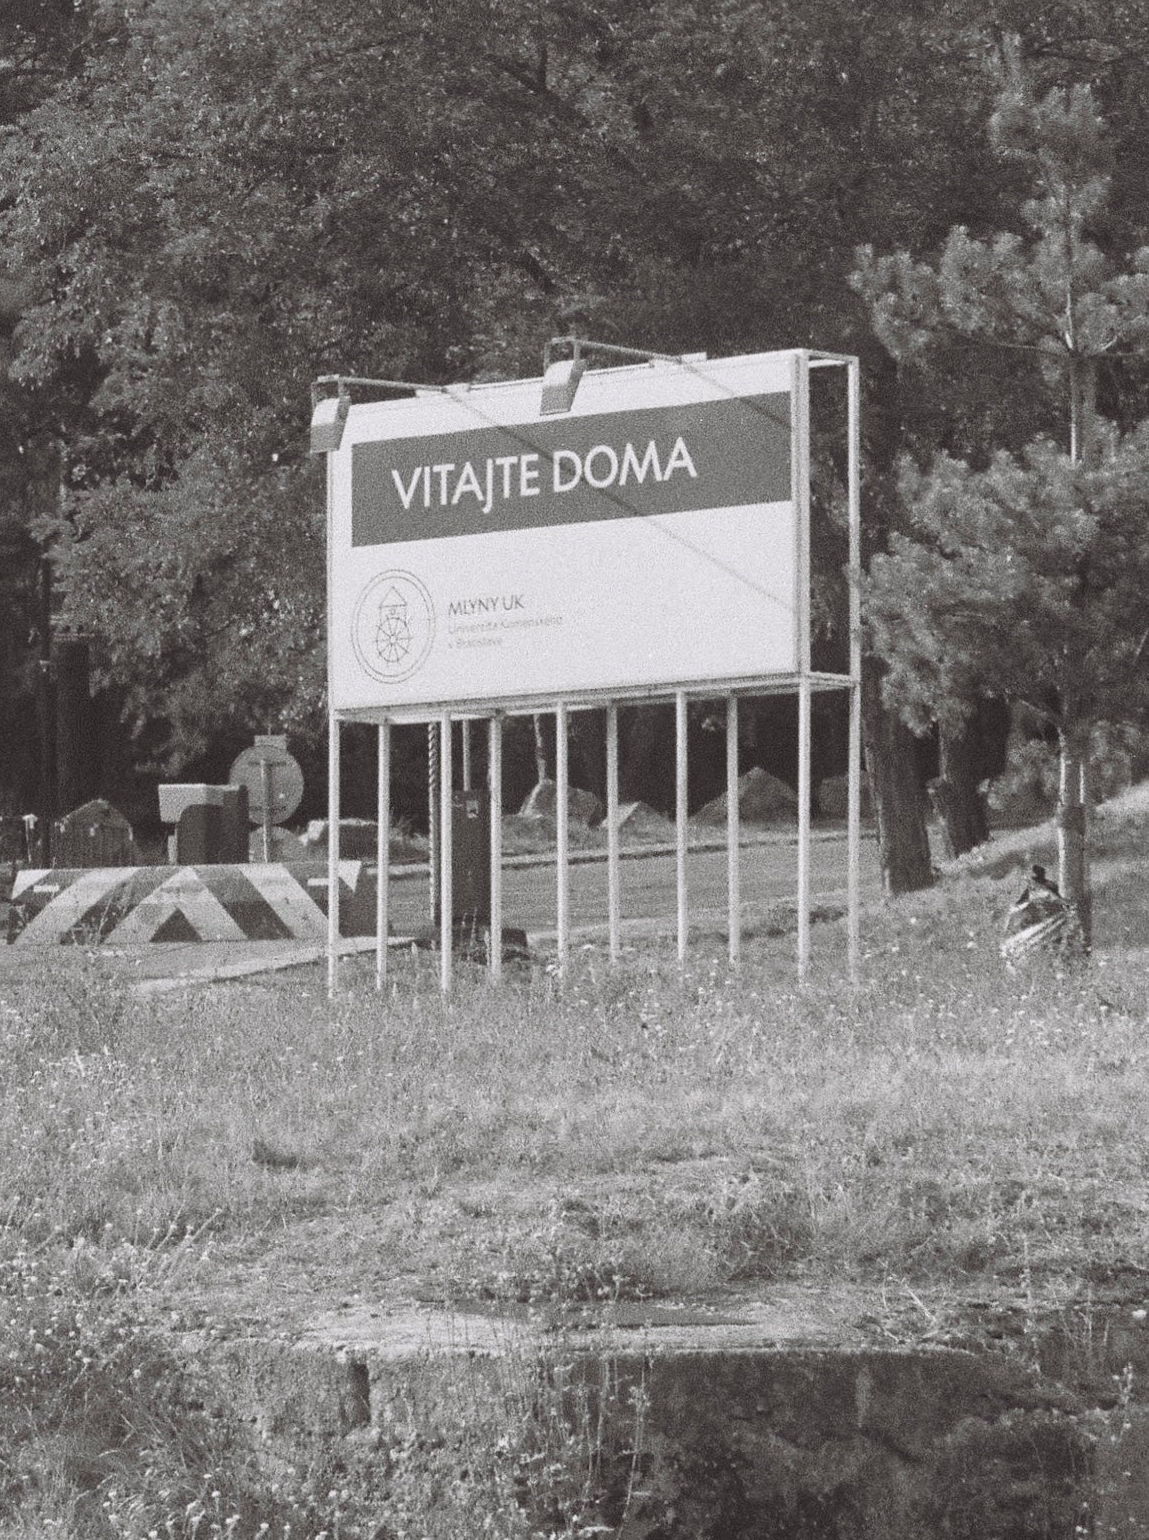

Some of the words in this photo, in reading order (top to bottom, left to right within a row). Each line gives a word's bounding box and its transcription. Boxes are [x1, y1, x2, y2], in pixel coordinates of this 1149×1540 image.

[391, 453, 541, 514] VITAJTE
[552, 436, 698, 494] DOMA
[448, 596, 499, 617] MLYNY
[502, 594, 525, 611] UK
